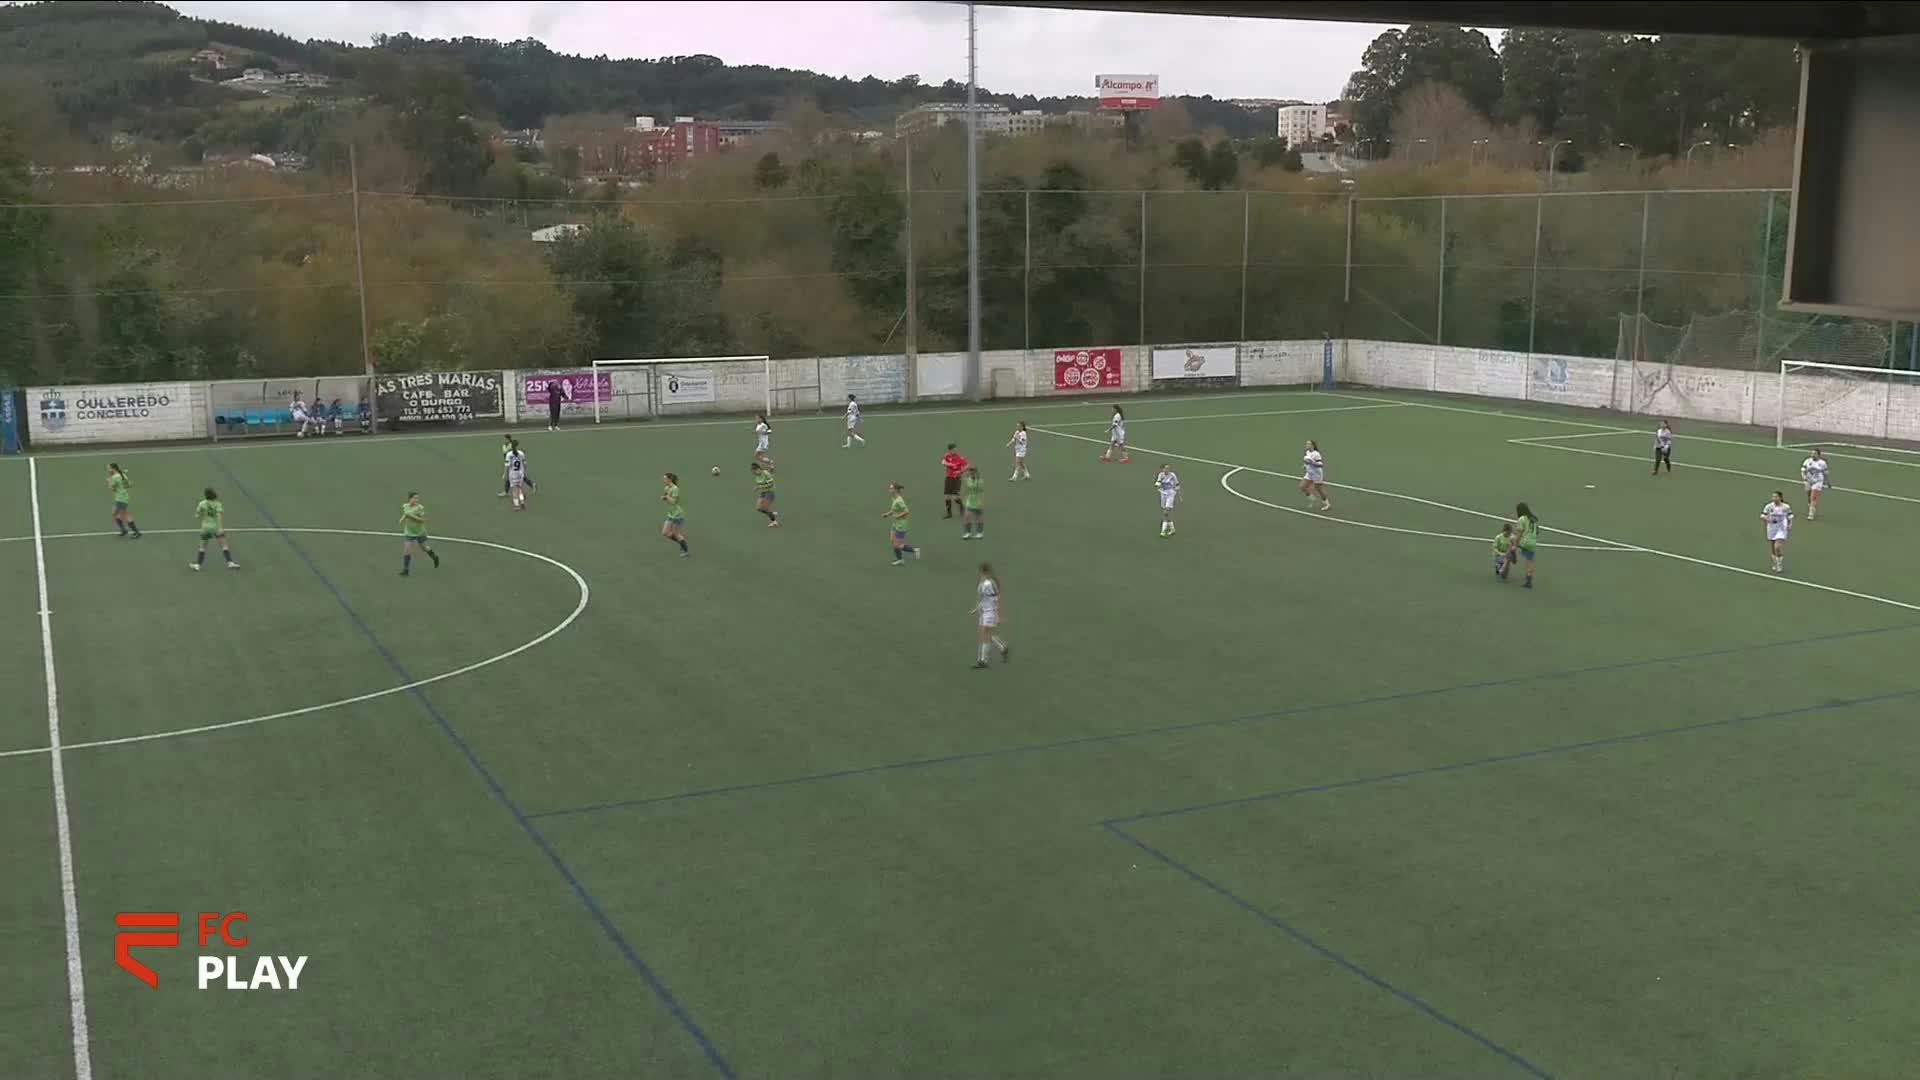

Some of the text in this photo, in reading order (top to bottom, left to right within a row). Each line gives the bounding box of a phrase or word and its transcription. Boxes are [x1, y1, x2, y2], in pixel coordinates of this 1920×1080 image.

[1102, 79, 1142, 91] Alcampo
[378, 373, 496, 396] AS TRES MARIAS
[444, 389, 470, 398] BAR
[77, 408, 149, 419] CONCELLO
[513, 460, 521, 471] 9
